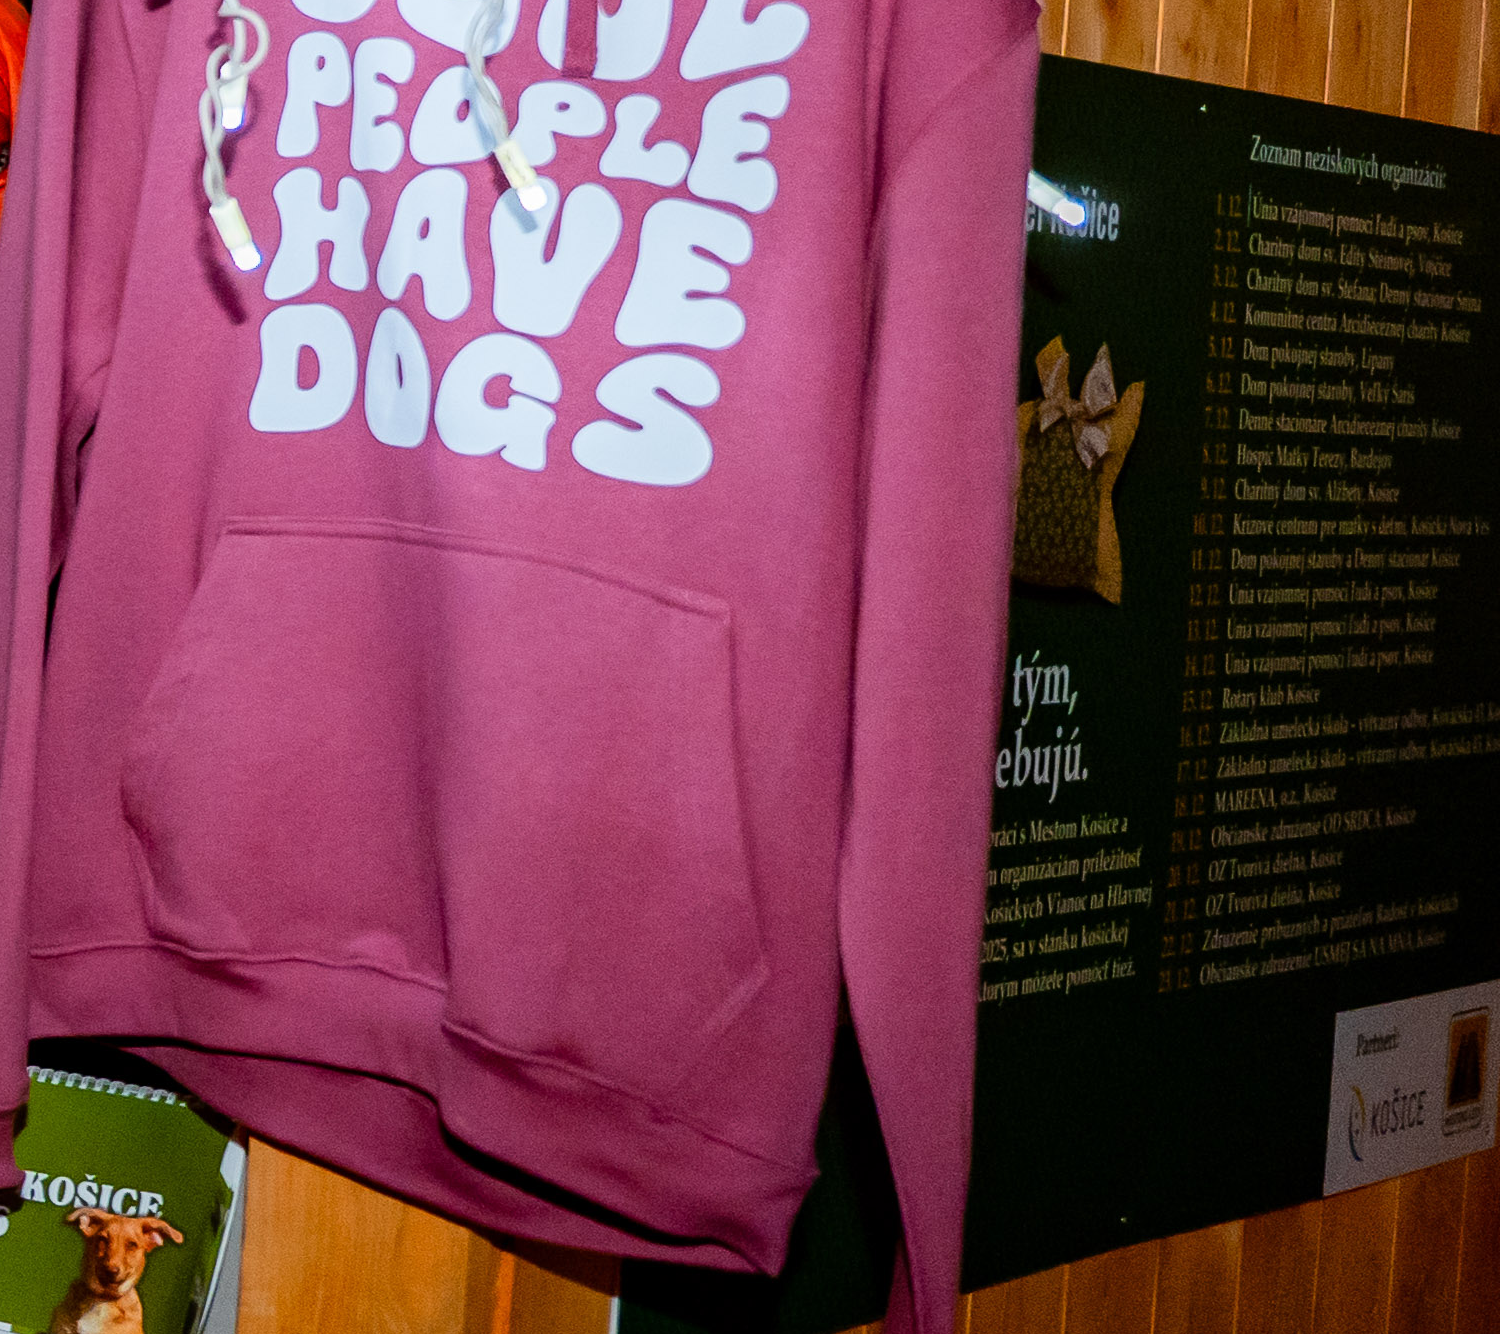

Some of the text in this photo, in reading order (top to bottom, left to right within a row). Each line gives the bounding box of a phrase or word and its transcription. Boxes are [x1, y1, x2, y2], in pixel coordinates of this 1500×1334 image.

[276, 31, 791, 214] PEOPLE
[1250, 134, 1302, 167] Zoznam
[1304, 145, 1379, 186] neziskových
[1051, 184, 1120, 242] ice
[263, 166, 754, 352] HAVE
[1243, 338, 1270, 362] Dom
[249, 301, 721, 487] DOGS
[1241, 372, 1268, 396] Dom
[1012, 649, 1078, 726] tým,
[995, 725, 1088, 804] ebujú.
[990, 821, 1018, 847] ráci
[1029, 819, 1078, 844] Mestom
[1079, 812, 1119, 837] Košice
[1120, 816, 1129, 833] a
[1000, 854, 1080, 892] organizáciám
[1047, 891, 1088, 916] Vianoc
[1090, 892, 1105, 911] na
[1107, 879, 1153, 910] Hlavnej
[1038, 926, 1079, 955] stánku
[1081, 917, 1130, 949] košickej
[1372, 1087, 1426, 1137] KOŠICE
[20, 1173, 165, 1219] KOŠICE
